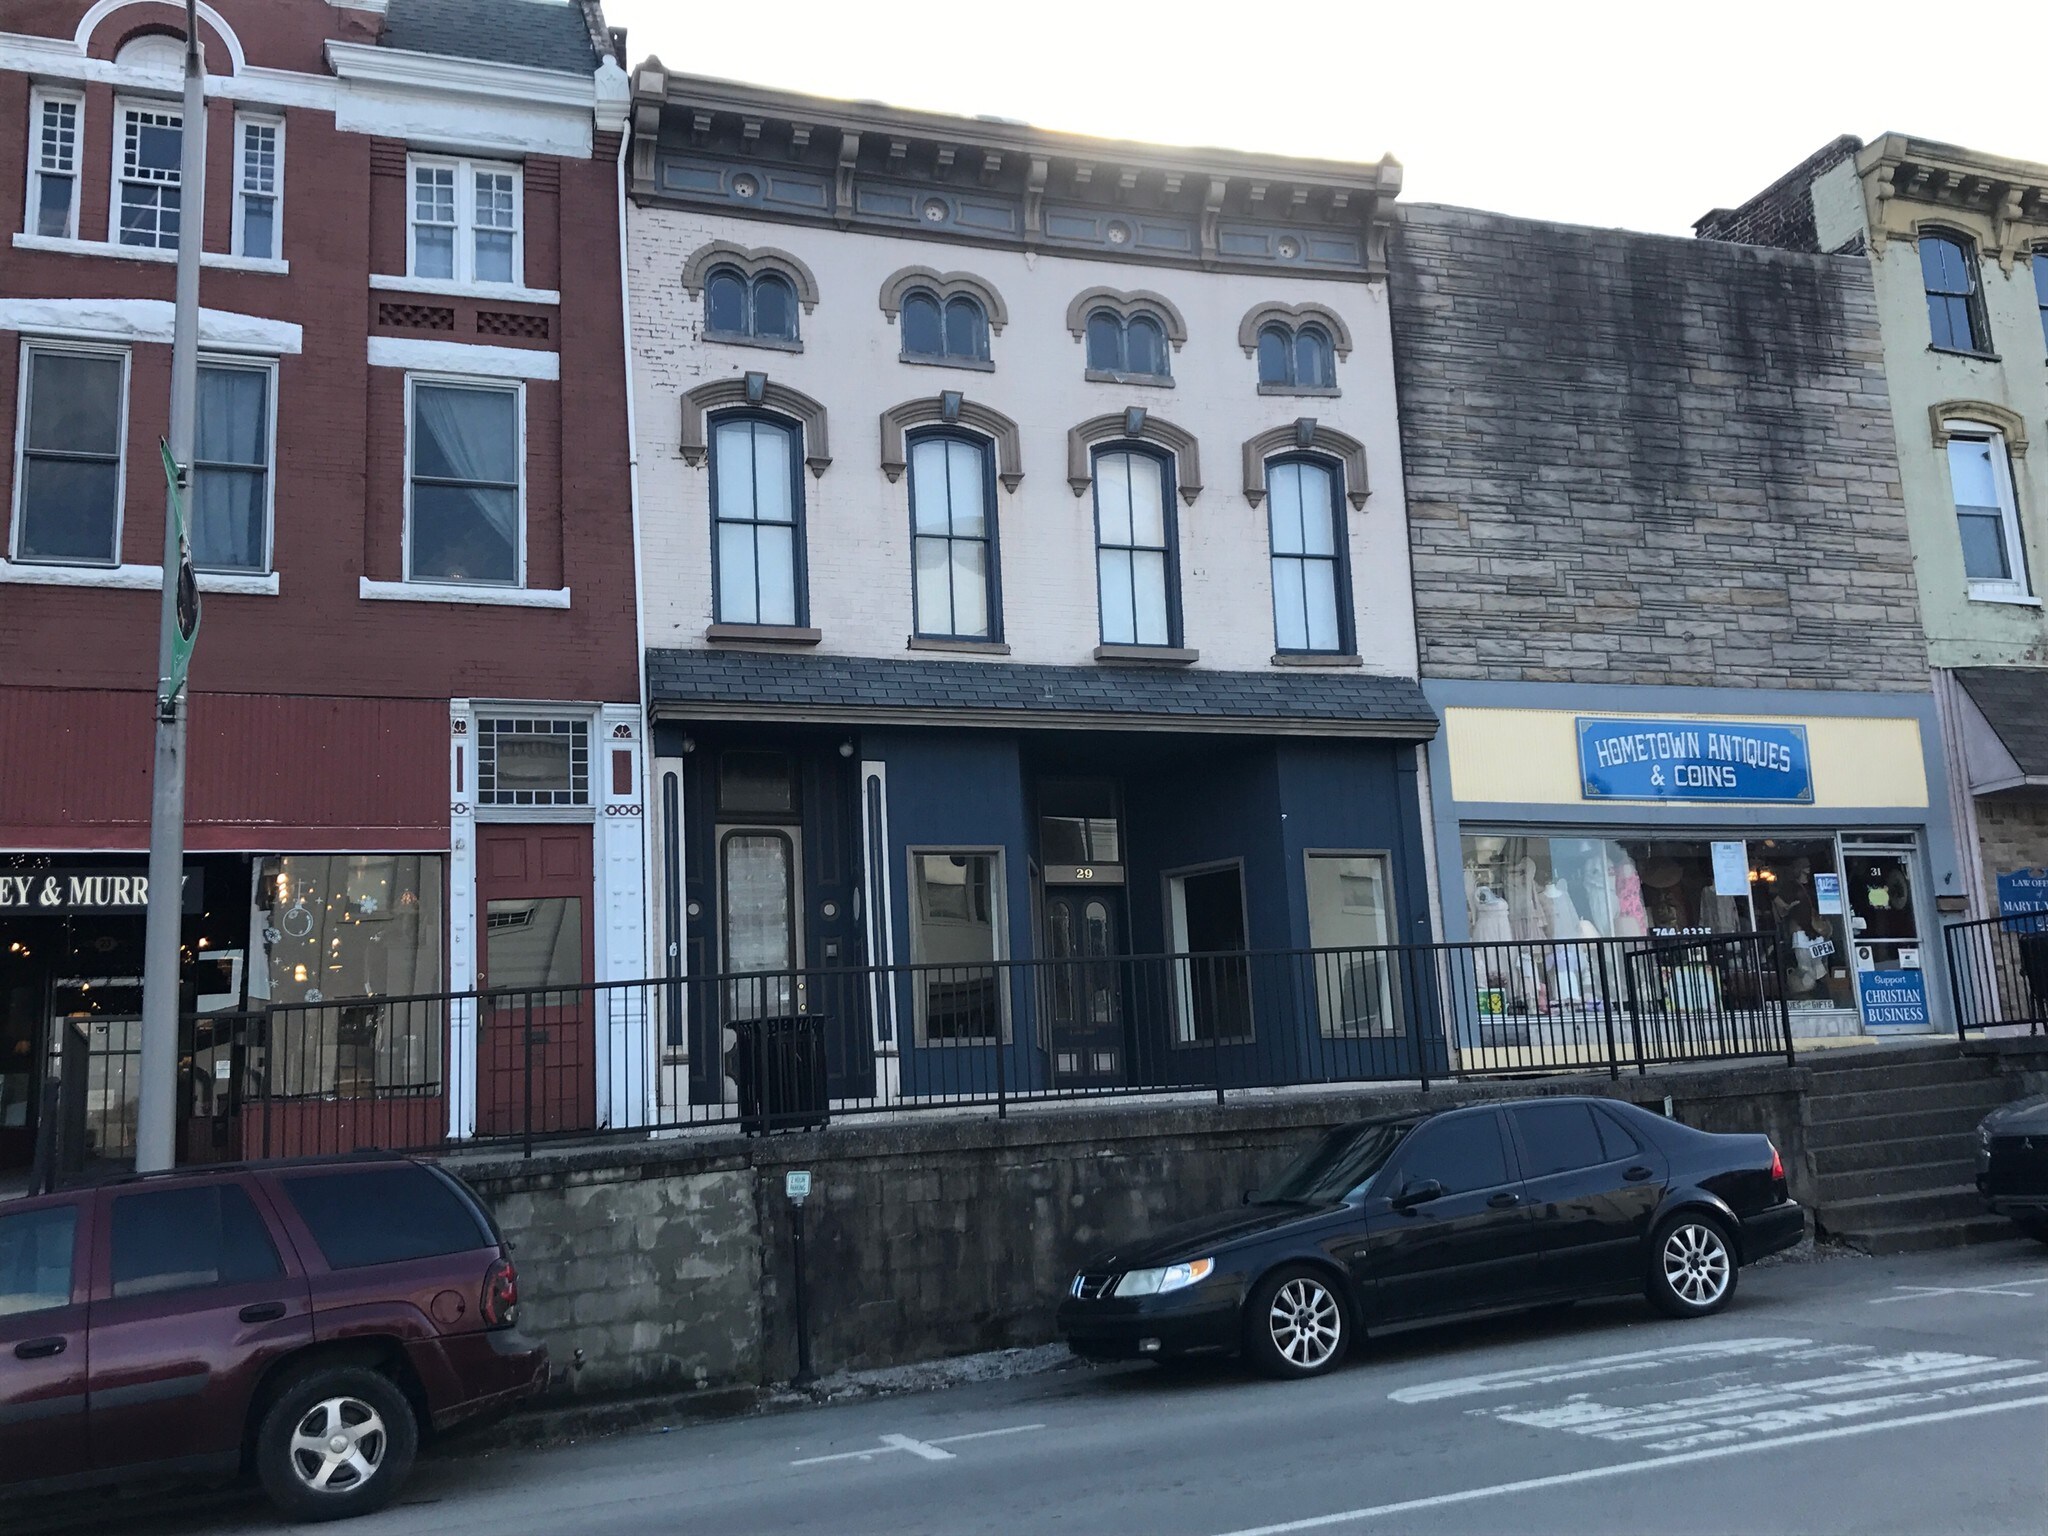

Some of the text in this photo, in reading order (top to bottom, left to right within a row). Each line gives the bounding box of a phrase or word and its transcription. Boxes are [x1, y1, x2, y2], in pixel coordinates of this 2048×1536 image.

[1594, 732, 1791, 773] HOMETOWN ANTIQUES
[1651, 764, 1737, 788] & COINS
[1076, 868, 1093, 879] 29
[1870, 867, 1881, 877] 31
[2012, 879, 2031, 887] LAW
[40, 876, 62, 906] &
[67, 876, 188, 906] MURR
[2004, 901, 2032, 911] MARY
[2033, 901, 2043, 911] T.
[1811, 943, 1834, 957] OPEN
[1874, 975, 1906, 986] Support
[1865, 989, 1920, 1003] CHRISTIAN
[1868, 1007, 1924, 1022] BUSINESS
